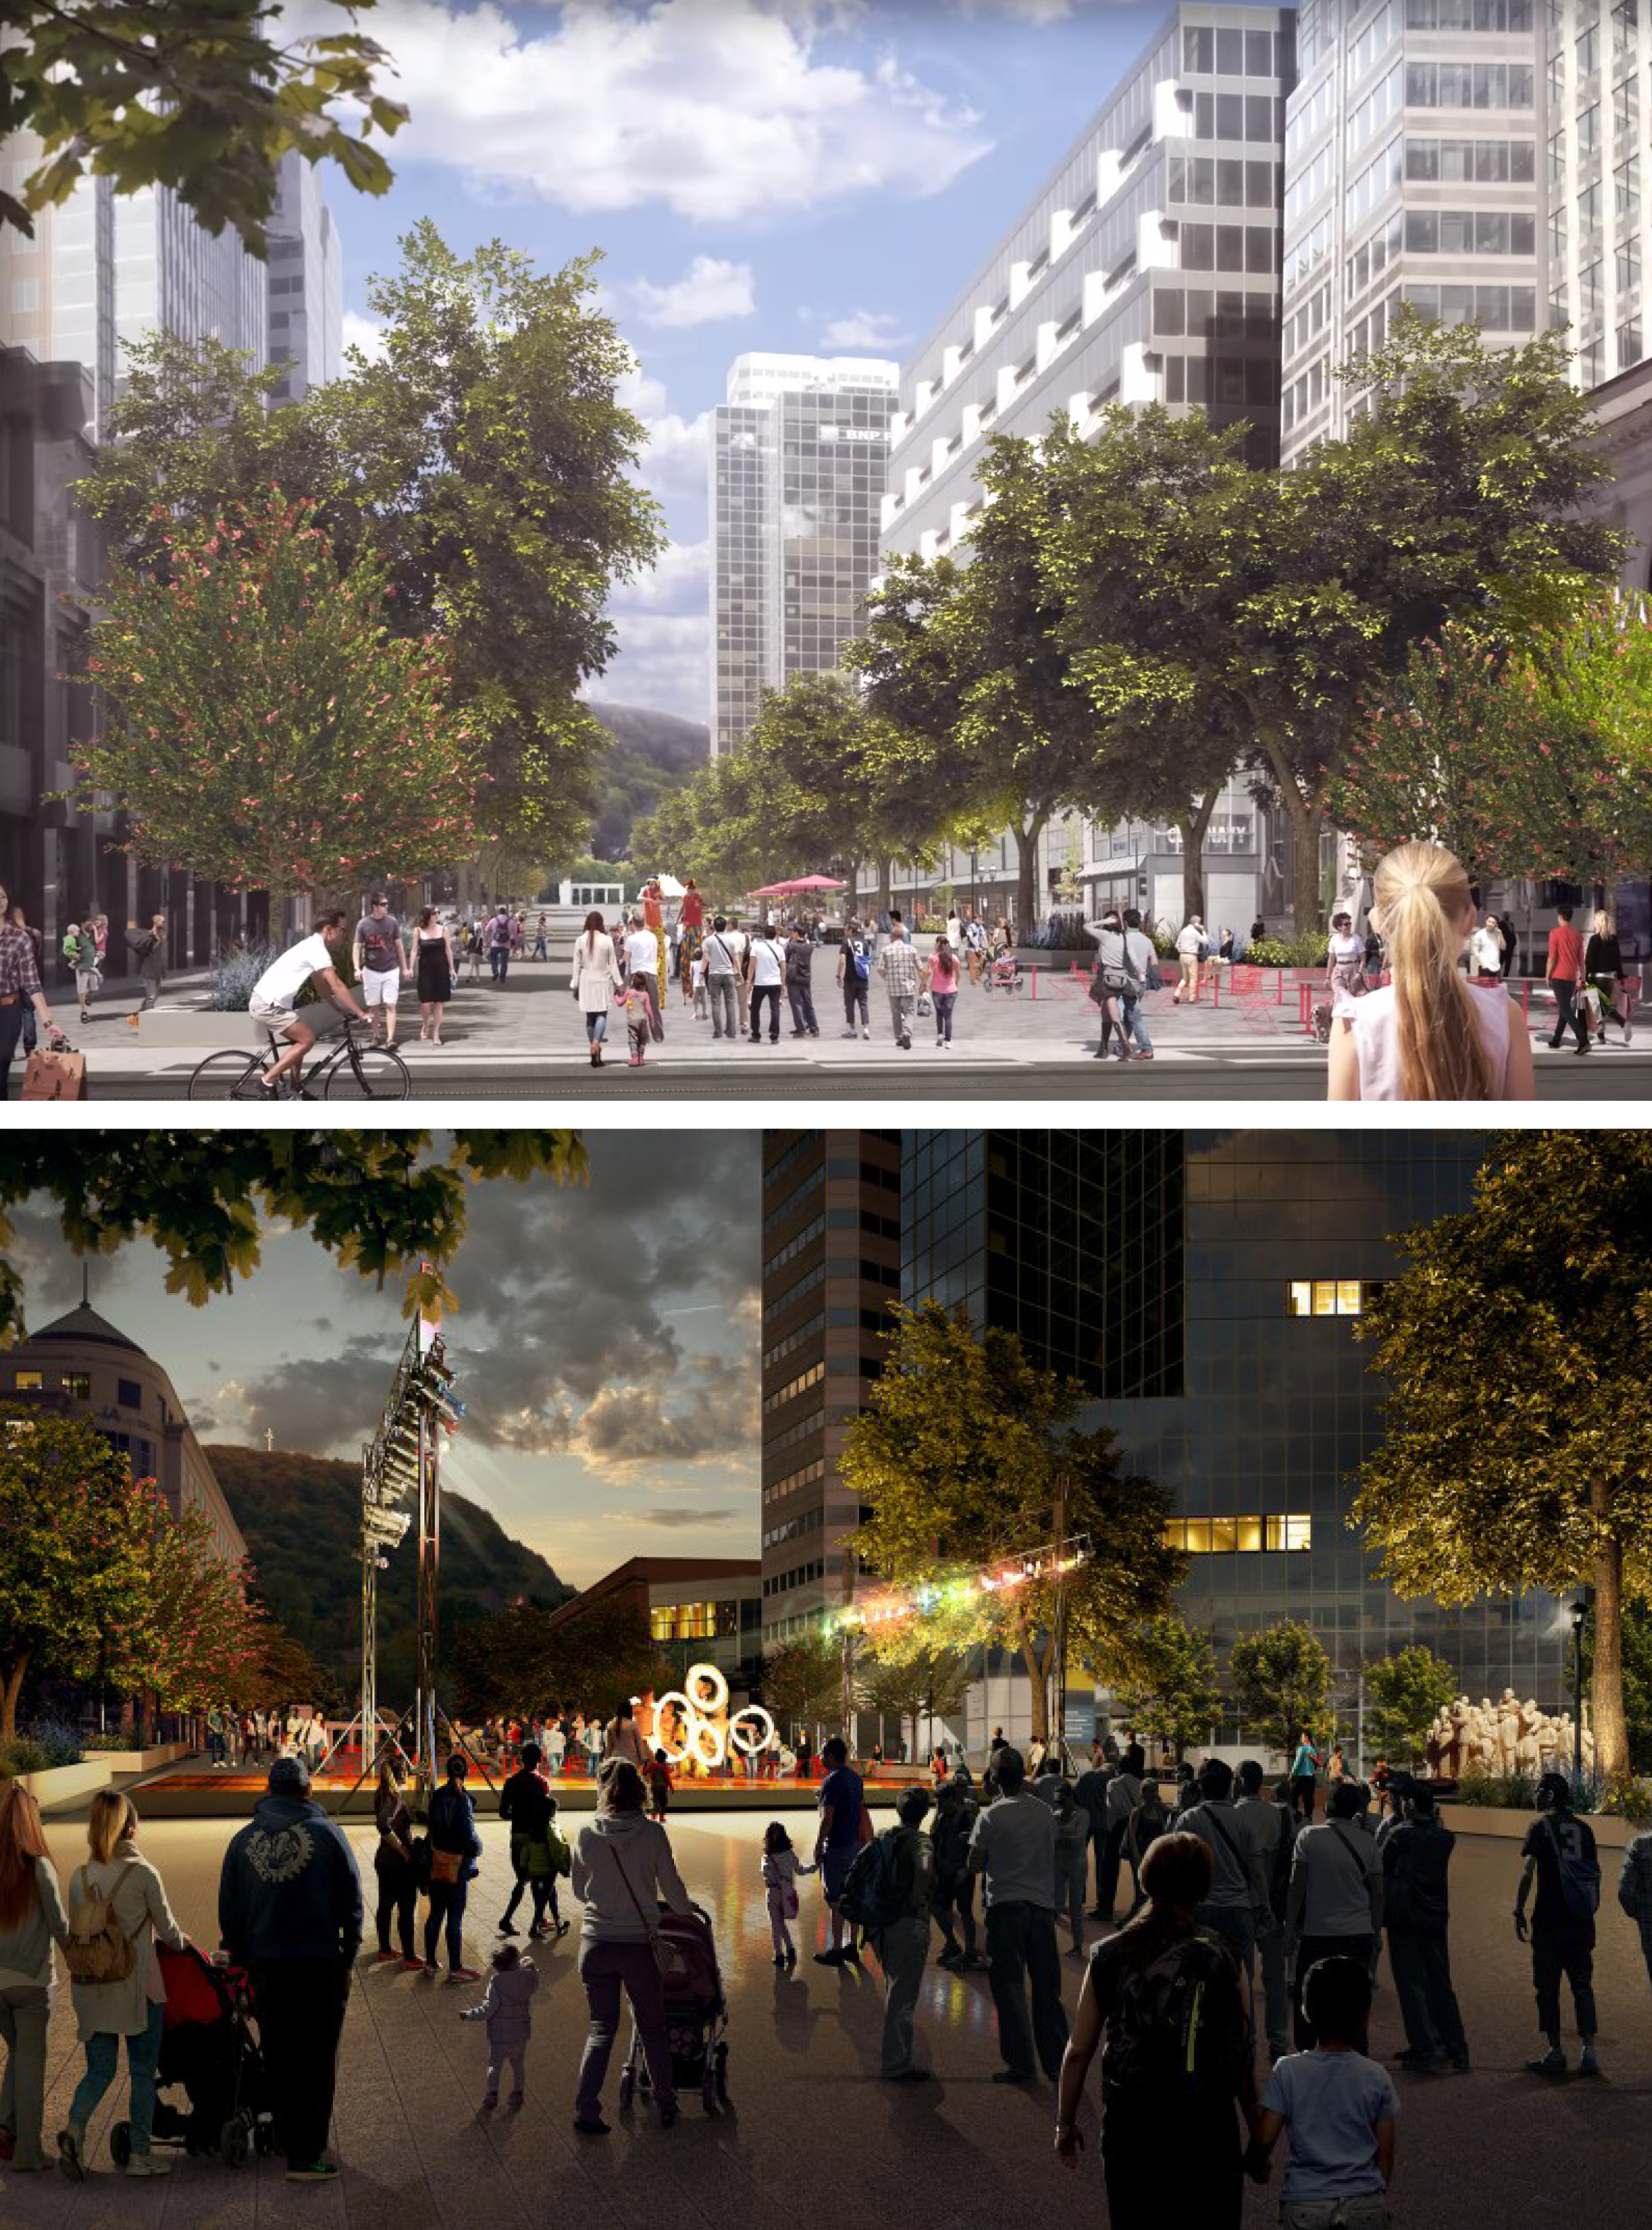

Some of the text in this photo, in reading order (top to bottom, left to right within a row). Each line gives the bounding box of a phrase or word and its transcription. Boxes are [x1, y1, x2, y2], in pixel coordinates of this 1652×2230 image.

[846, 429, 880, 440] BNP
[1208, 826, 1246, 844] NAVY
[854, 941, 864, 956] 3
[1560, 1823, 1582, 1861] 3
